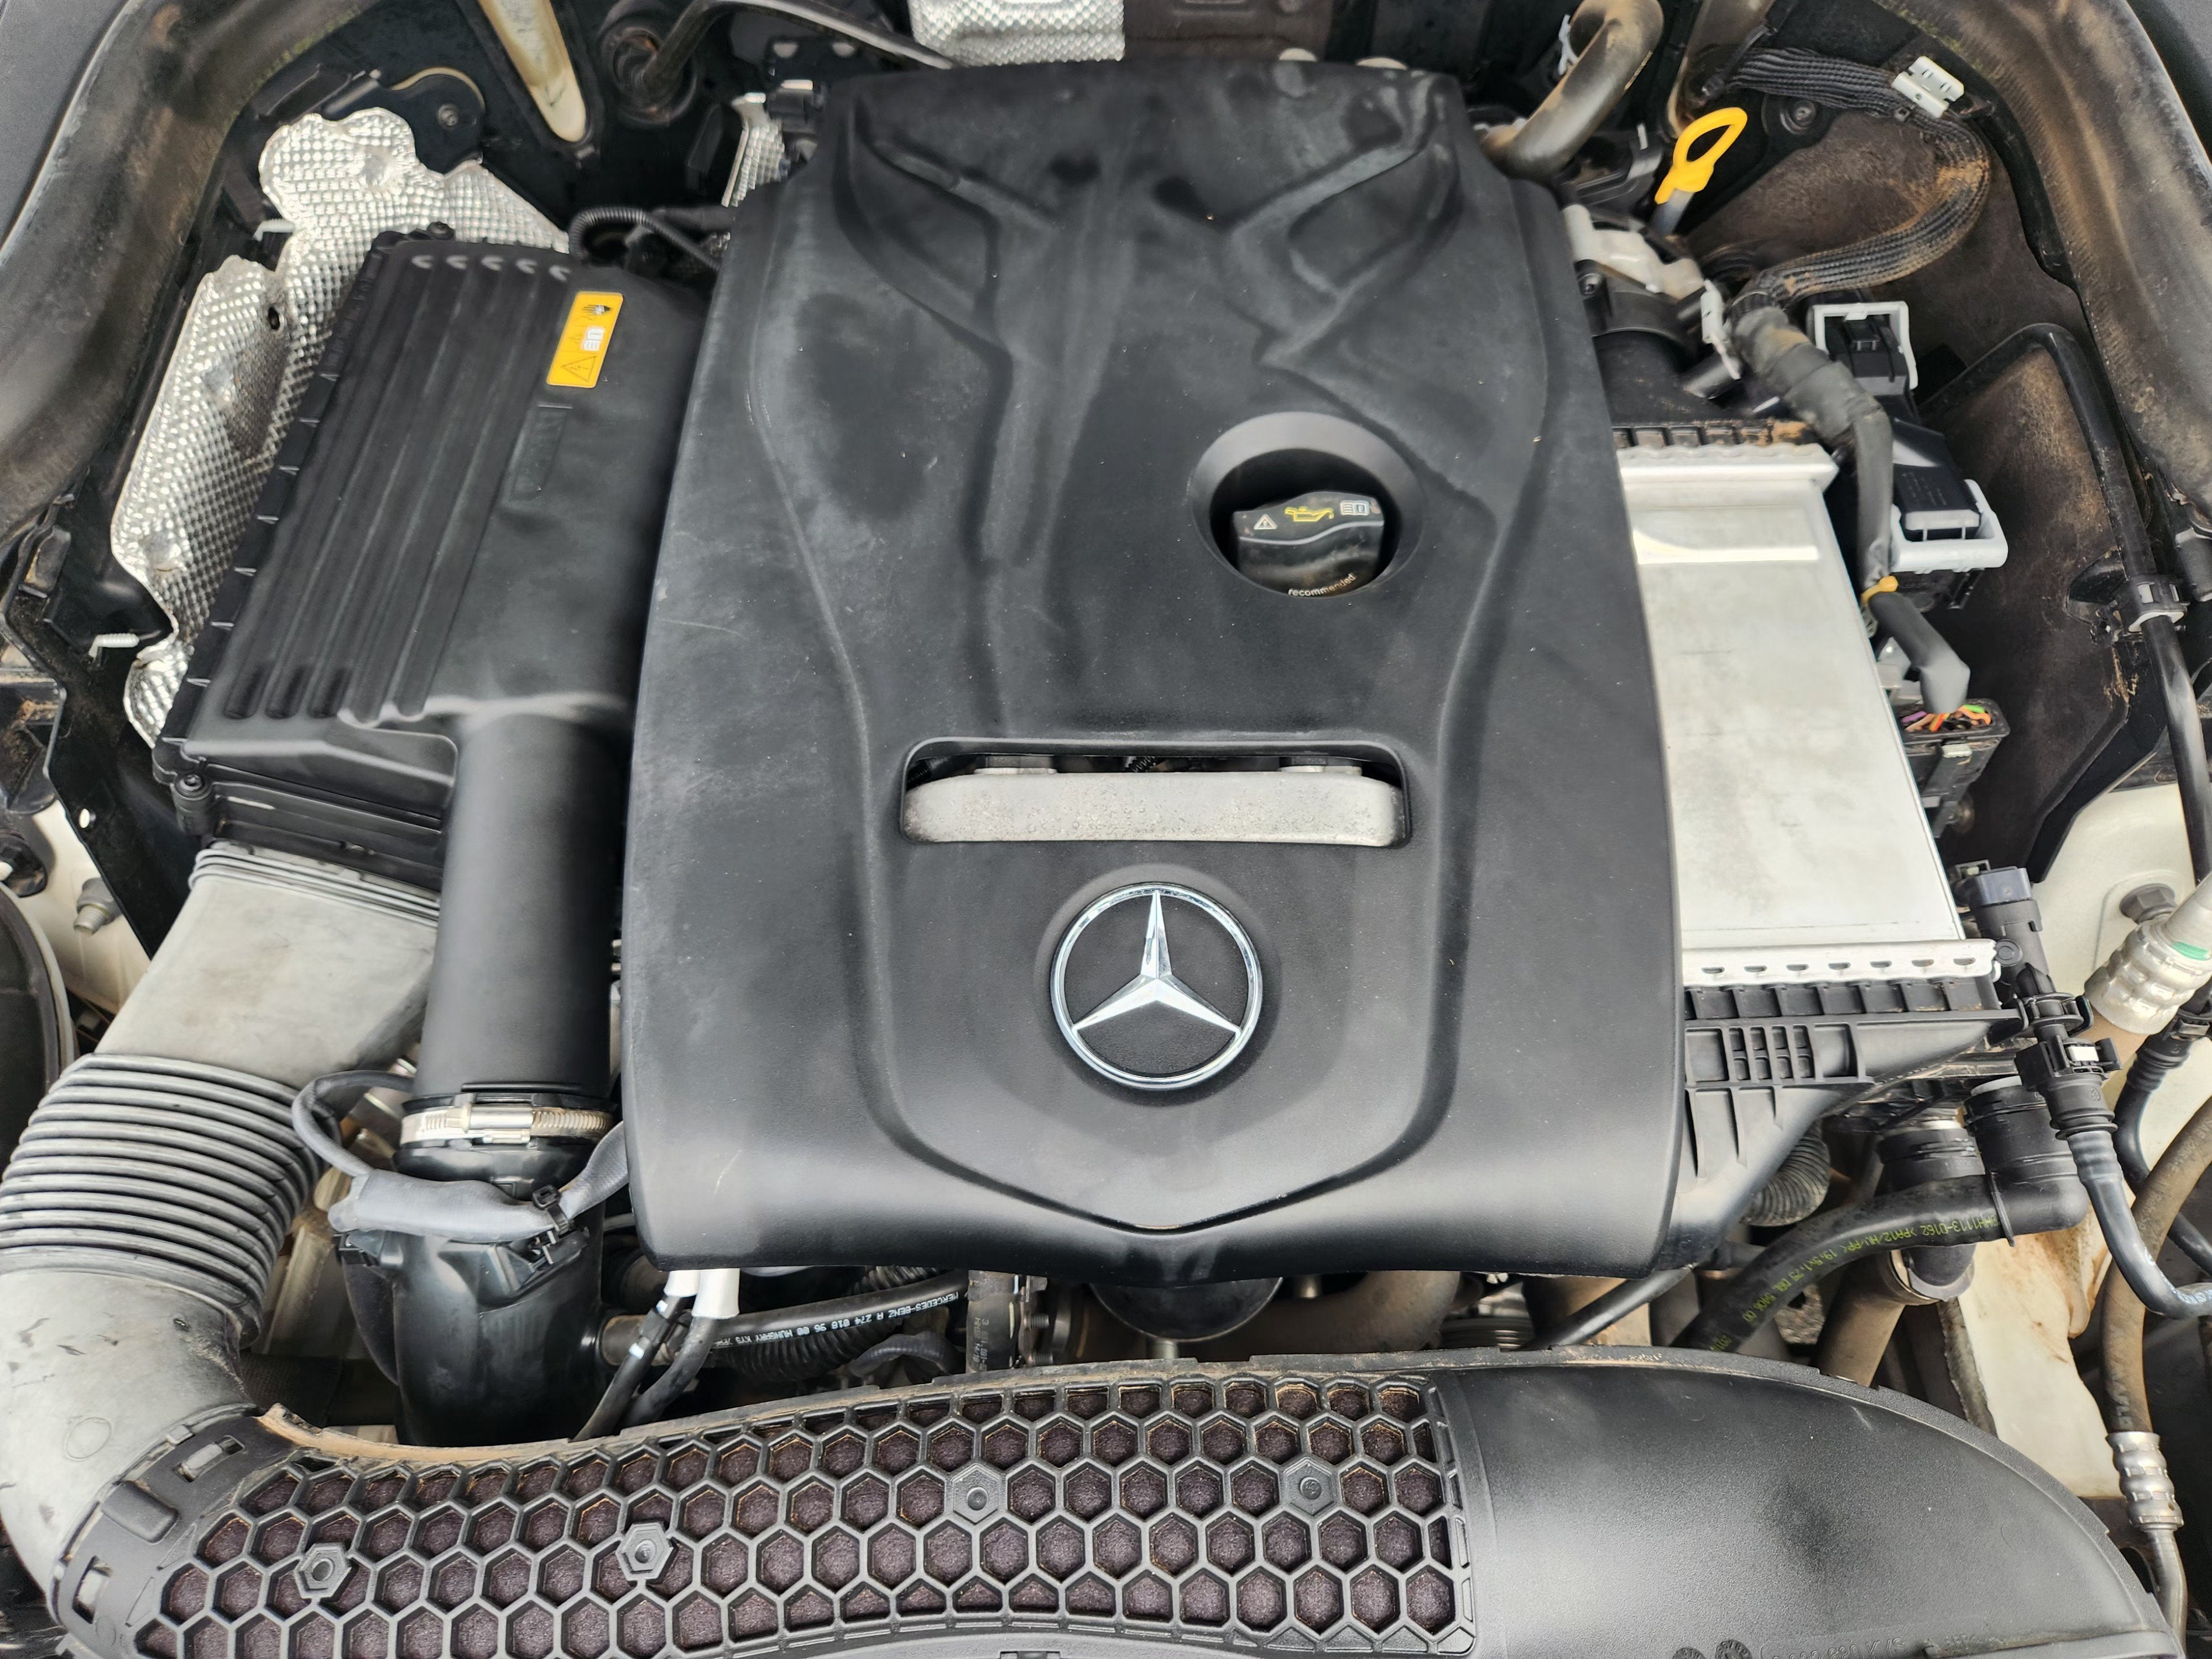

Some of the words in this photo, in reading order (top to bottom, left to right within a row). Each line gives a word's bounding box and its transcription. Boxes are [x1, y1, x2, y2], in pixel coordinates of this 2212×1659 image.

[1287, 573, 1357, 596] recommended
[888, 1291, 959, 1318] MERCEDES-BENZ
[854, 1313, 873, 1324] 274
[876, 1311, 884, 1321] A
[831, 1319, 851, 1329] 018
[755, 1329, 794, 1342] HUNGARY
